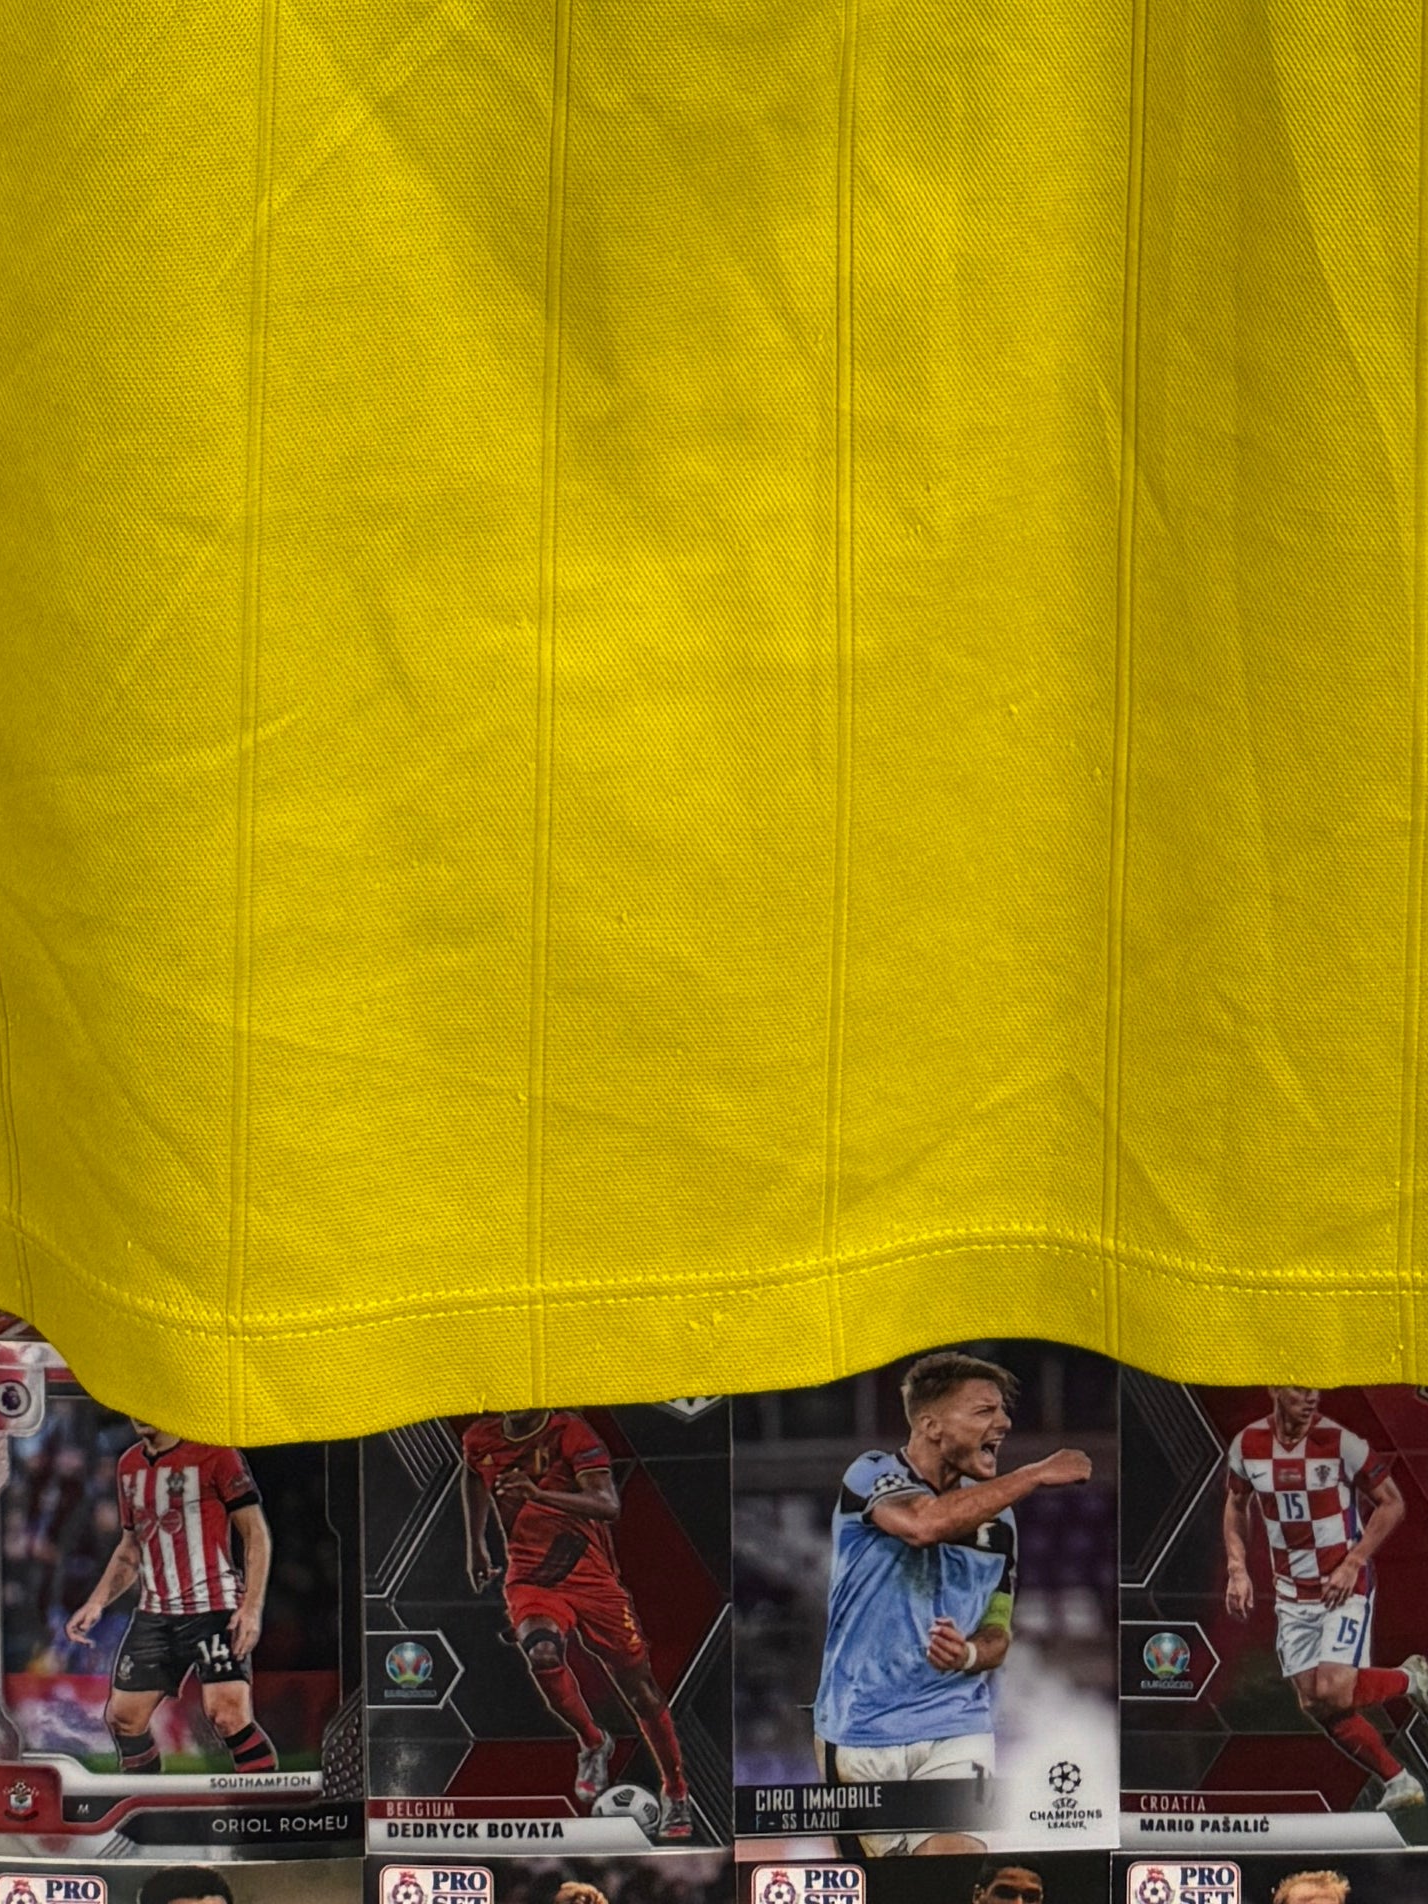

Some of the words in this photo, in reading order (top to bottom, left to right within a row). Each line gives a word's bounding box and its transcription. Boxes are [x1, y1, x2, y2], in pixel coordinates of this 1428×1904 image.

[1282, 1491, 1305, 1522] 15
[1336, 1615, 1359, 1645] 15
[197, 1637, 230, 1664] 14
[209, 1774, 313, 1790] SOUTHAMPTON
[755, 1789, 798, 1812] CIRO
[802, 1785, 882, 1810] IMMOBILE
[1140, 1795, 1206, 1813] CROATIA
[386, 1800, 455, 1818] BELGIUM
[1029, 1808, 1103, 1821] CHAMPIONS
[211, 1815, 275, 1835] ORIOL
[279, 1814, 350, 1834] ROMEU
[802, 1812, 841, 1829] LAZIO
[1139, 1817, 1195, 1834] MARIO
[1199, 1813, 1271, 1835] PAŠALIĆ
[386, 1821, 481, 1841] DEDRYCK
[487, 1821, 565, 1841] BOYATA
